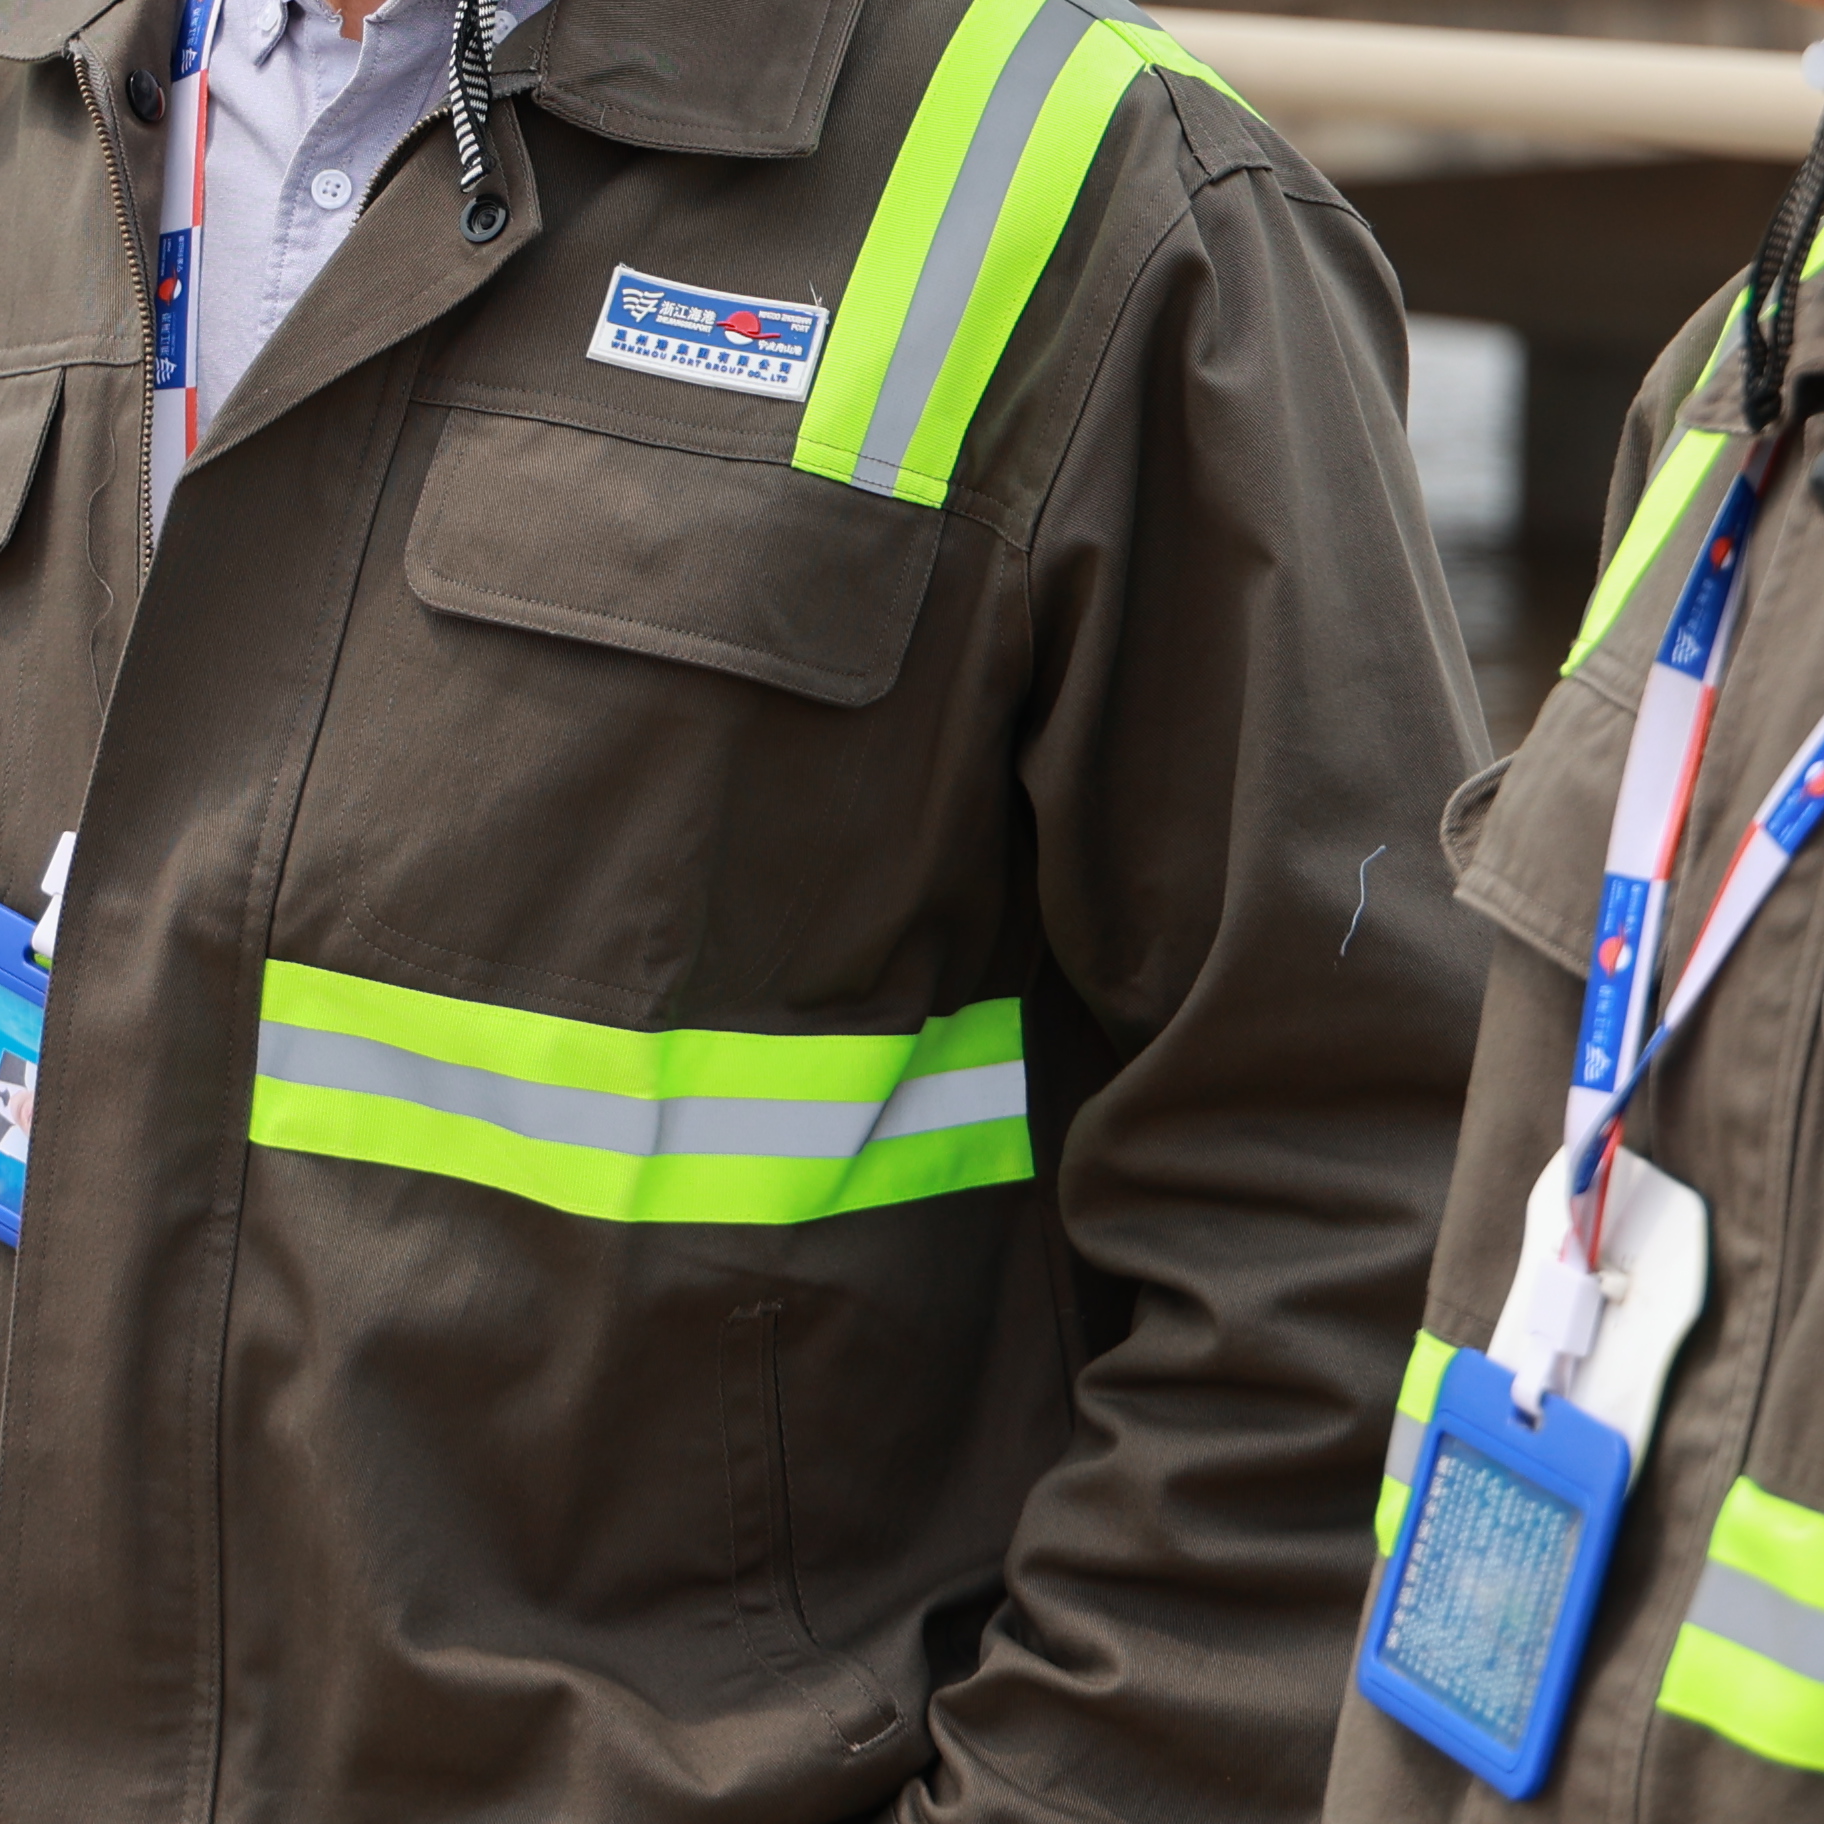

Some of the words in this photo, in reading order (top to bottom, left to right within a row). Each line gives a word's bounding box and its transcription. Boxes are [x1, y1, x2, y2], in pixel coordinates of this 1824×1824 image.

[658, 300, 717, 325] 浙江海港
[611, 340, 667, 360] WENZHOU
[670, 354, 702, 368] PORT
[705, 361, 744, 376] GROUP
